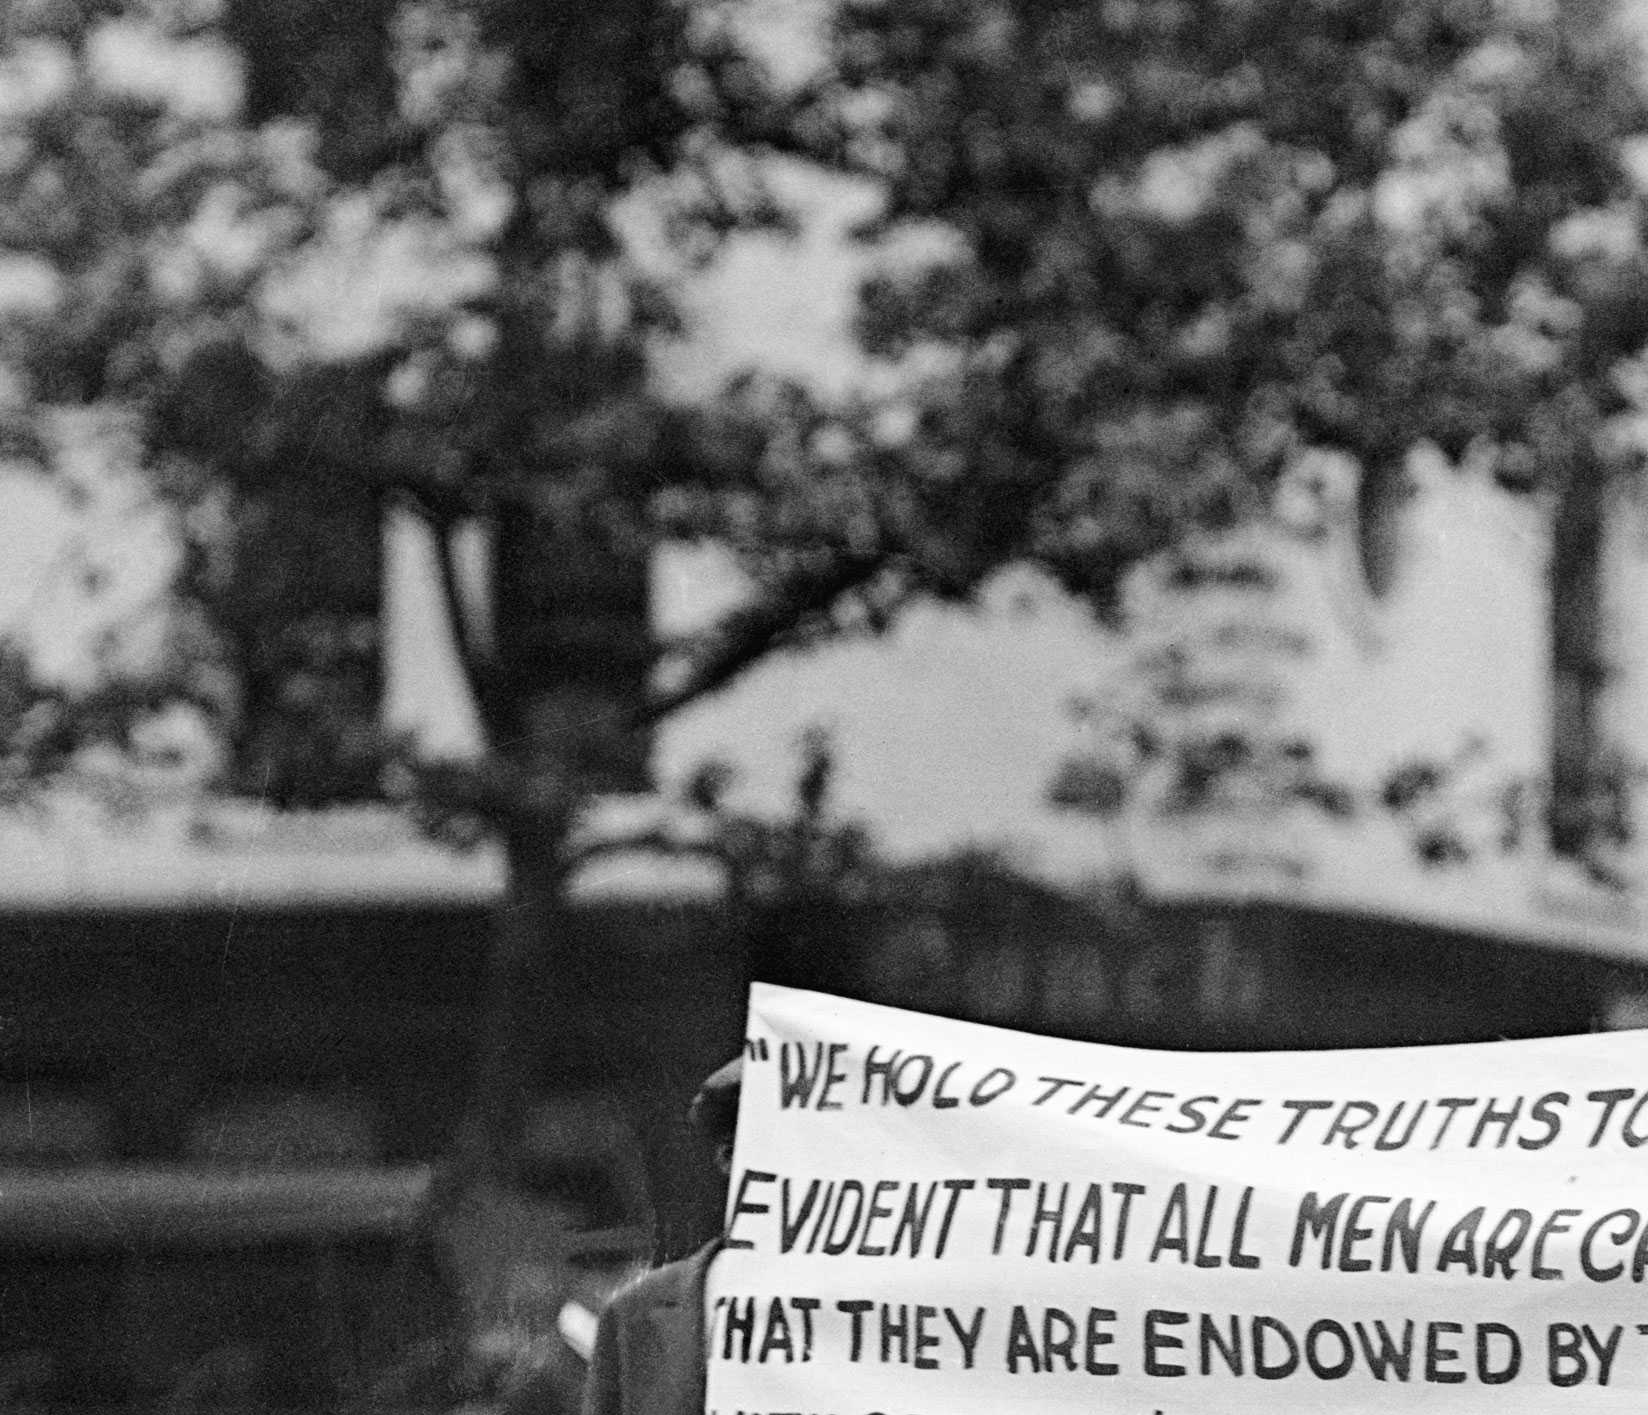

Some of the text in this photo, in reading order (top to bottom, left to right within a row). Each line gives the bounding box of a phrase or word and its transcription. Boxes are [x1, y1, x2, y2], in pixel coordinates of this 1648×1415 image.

[862, 1045, 1016, 1110] HOLD
[1036, 1077, 1261, 1140] THESE
[1280, 1091, 1570, 1151] TRUTHS
[726, 1169, 975, 1258] EVIDENT
[986, 1178, 1146, 1264] THAT
[1149, 1182, 1260, 1269] ALL
[1289, 1192, 1435, 1274] MEN
[1436, 1208, 1580, 1281] ARE
[835, 1299, 986, 1370] THEY
[1005, 1305, 1120, 1377] ARE
[1143, 1309, 1523, 1385] ENDOWED
[1547, 1322, 1624, 1388] BY
